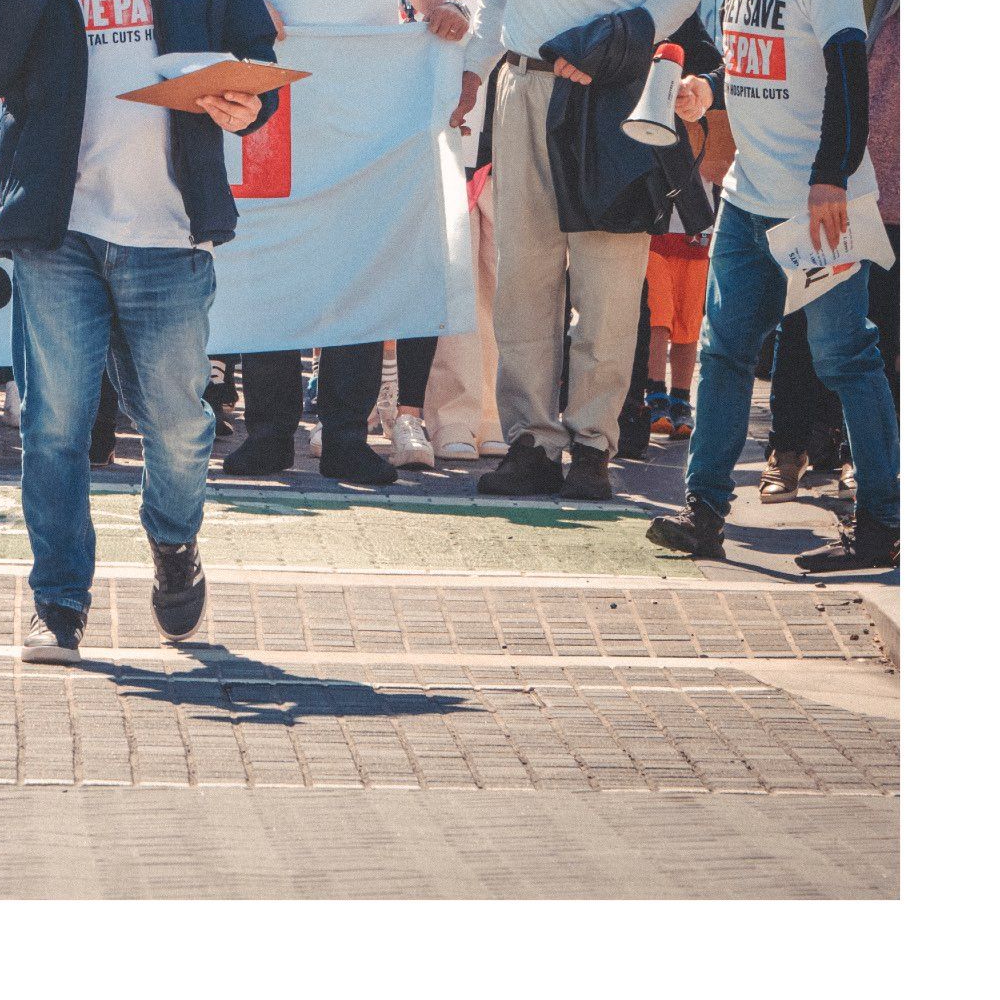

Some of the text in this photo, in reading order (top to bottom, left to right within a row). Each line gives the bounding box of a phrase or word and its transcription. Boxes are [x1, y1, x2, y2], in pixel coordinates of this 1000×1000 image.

[88, 33, 109, 47] TAL
[112, 30, 141, 44] CUTS
[736, 35, 775, 76] PAY
[730, 84, 761, 99] HOSPITAL
[762, 87, 790, 100] CUTS
